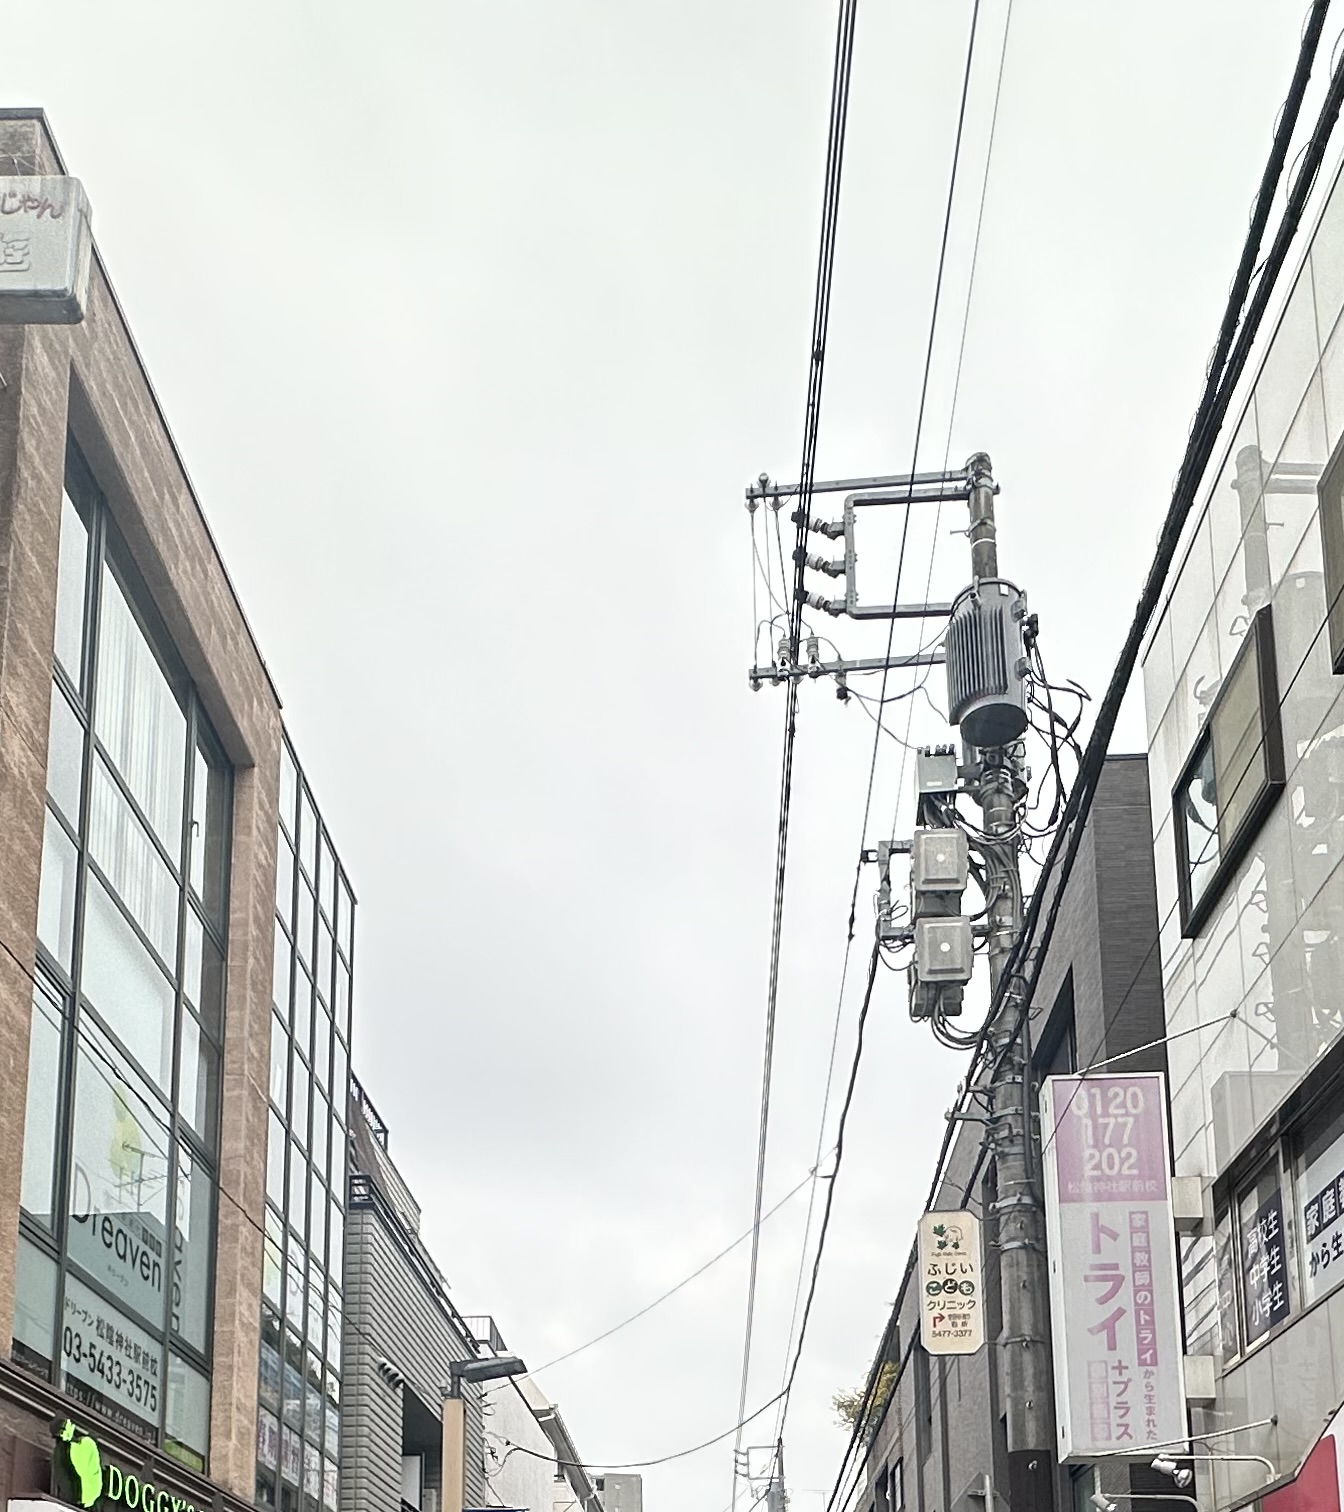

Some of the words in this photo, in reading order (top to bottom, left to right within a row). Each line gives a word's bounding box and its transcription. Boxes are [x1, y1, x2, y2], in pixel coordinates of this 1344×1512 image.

[1071, 1086, 1145, 1116] 0120
[1082, 1117, 1135, 1146] 177
[1083, 1147, 1140, 1176] 202
[1247, 1208, 1280, 1262] 高校生
[927, 1262, 974, 1276] ふじい
[1083, 1212, 1127, 1351] トライ
[1249, 1245, 1282, 1290] 中学生
[927, 1280, 974, 1295] こども
[927, 1299, 976, 1311] クリニック
[1130, 1211, 1158, 1366] 家庭教師のトライ
[1252, 1280, 1285, 1326] 小学生
[63, 1326, 158, 1412] 03-5433-3575
